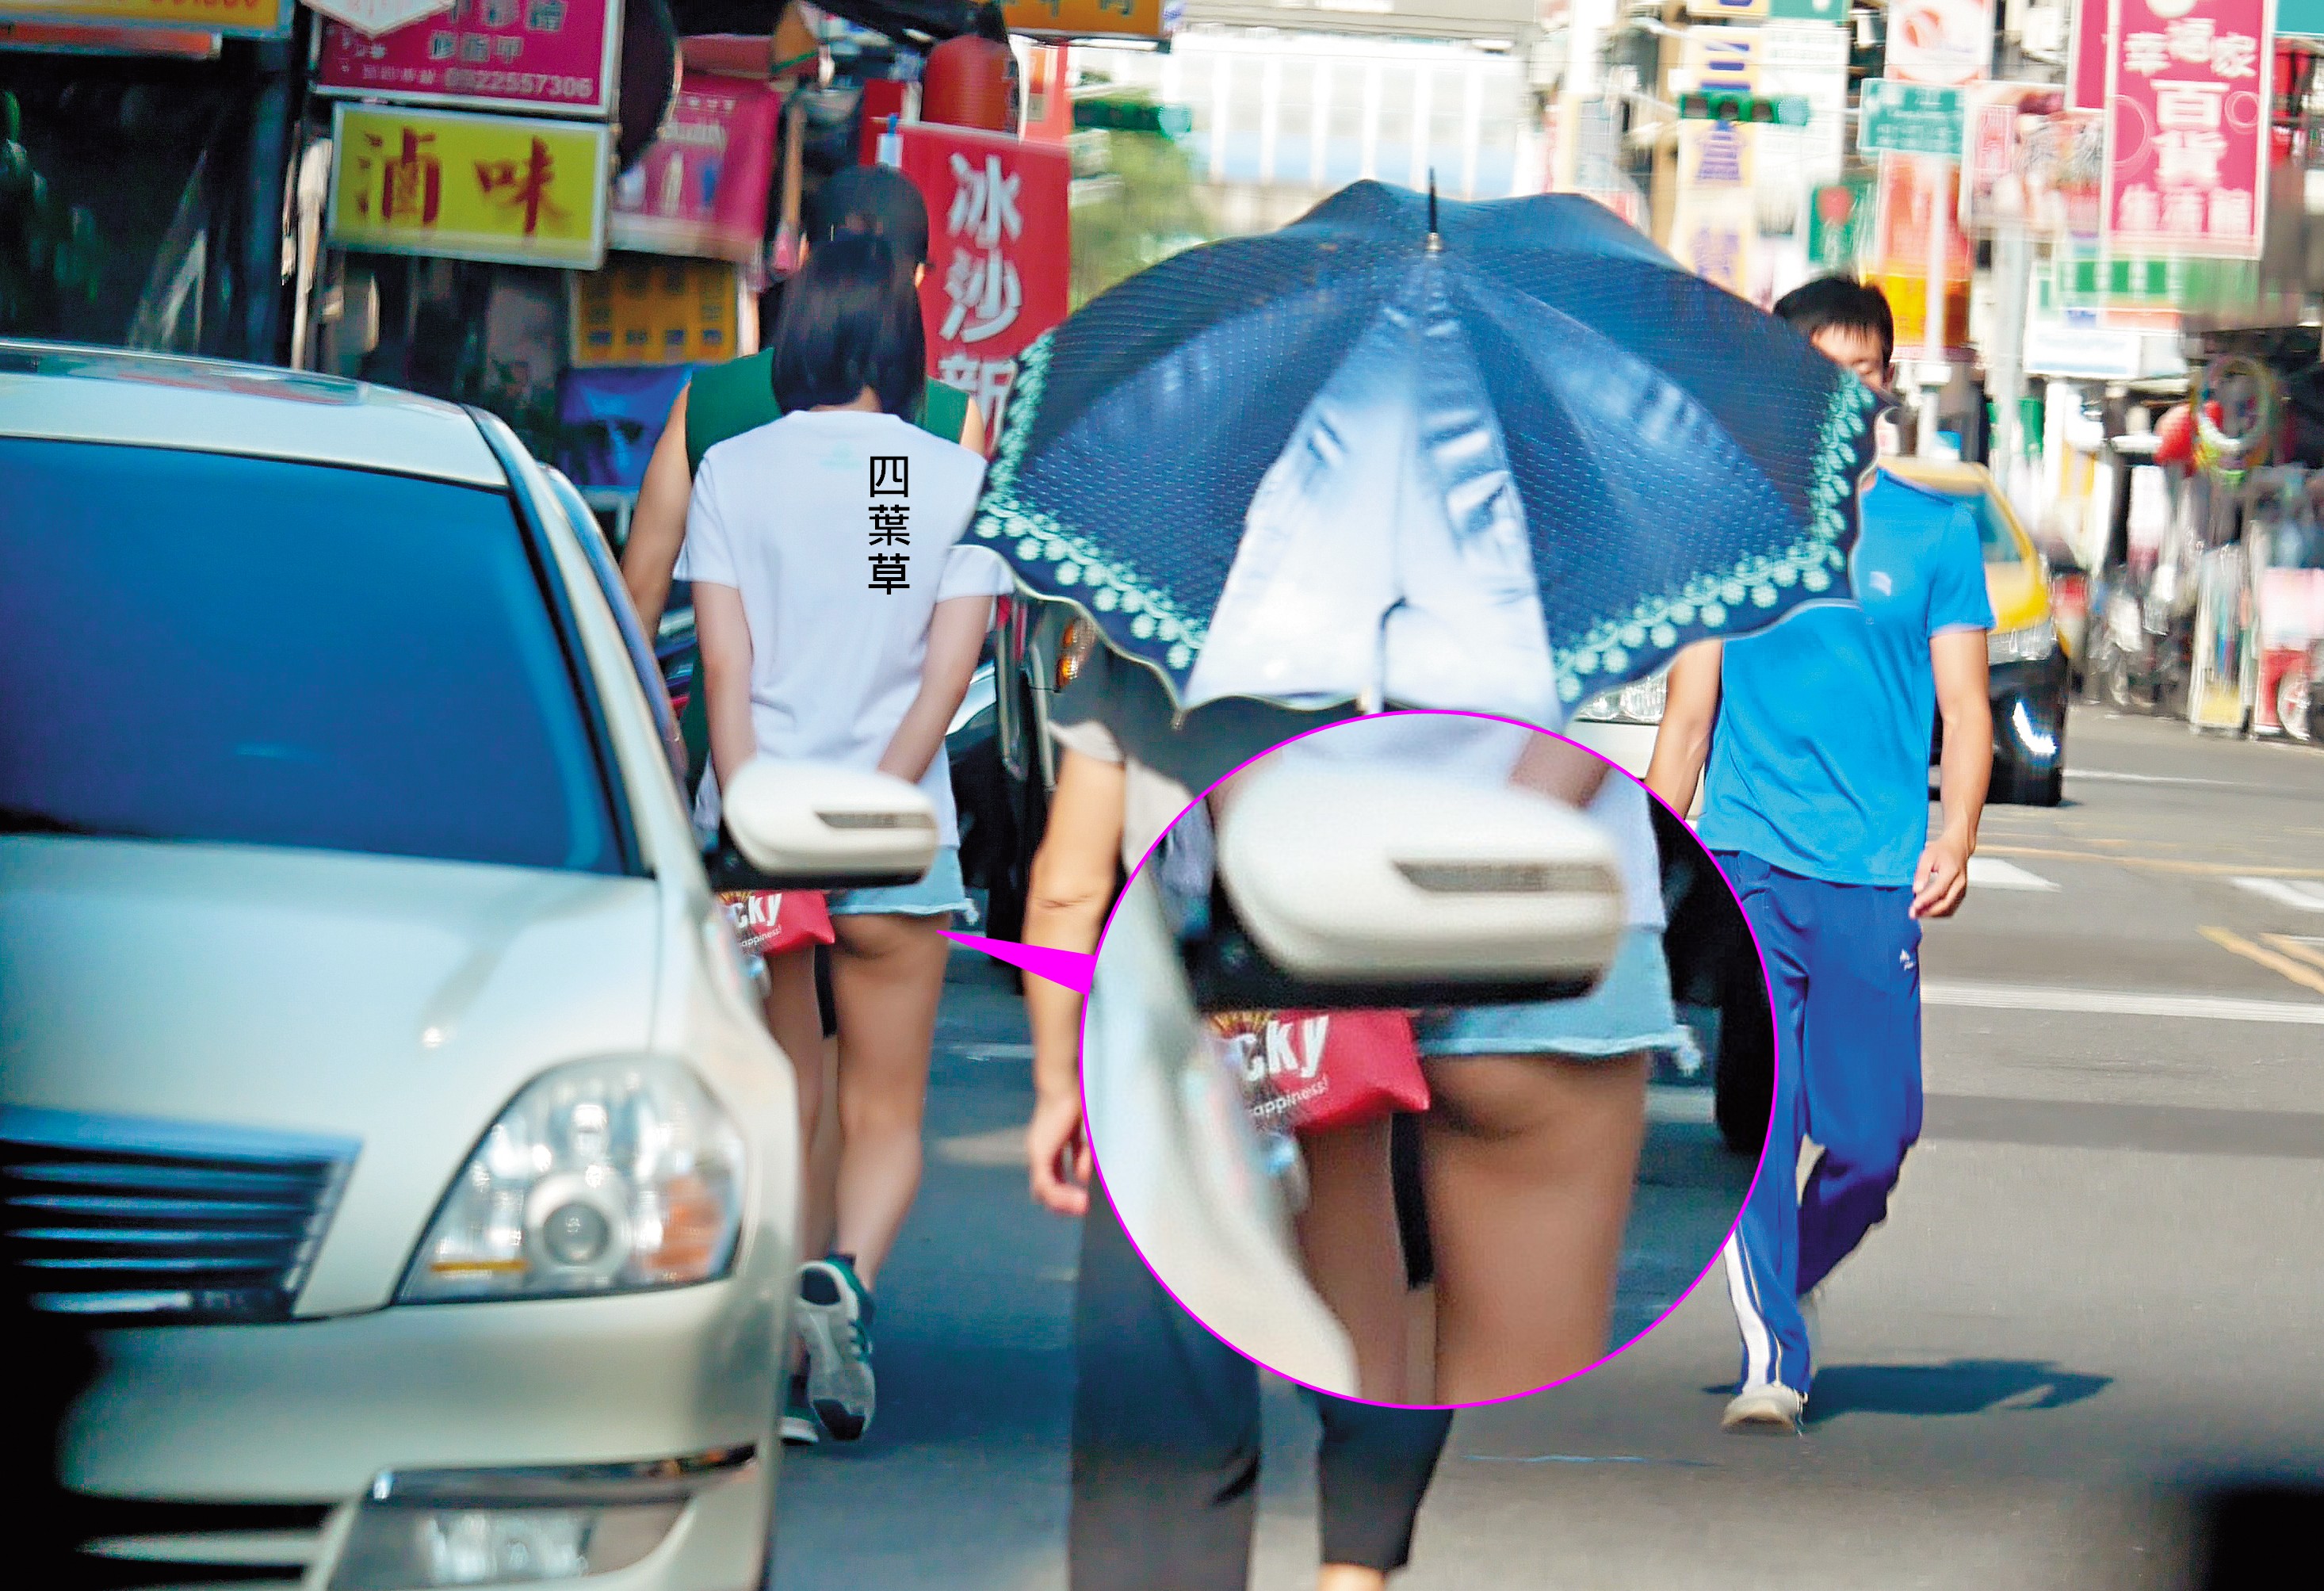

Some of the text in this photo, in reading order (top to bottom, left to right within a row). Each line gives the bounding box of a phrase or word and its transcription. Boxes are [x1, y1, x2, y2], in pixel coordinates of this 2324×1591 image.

[2149, 78, 2232, 193] 百貨
[740, 924, 782, 948] appiness!
[1248, 1074, 1330, 1116] appiness!
